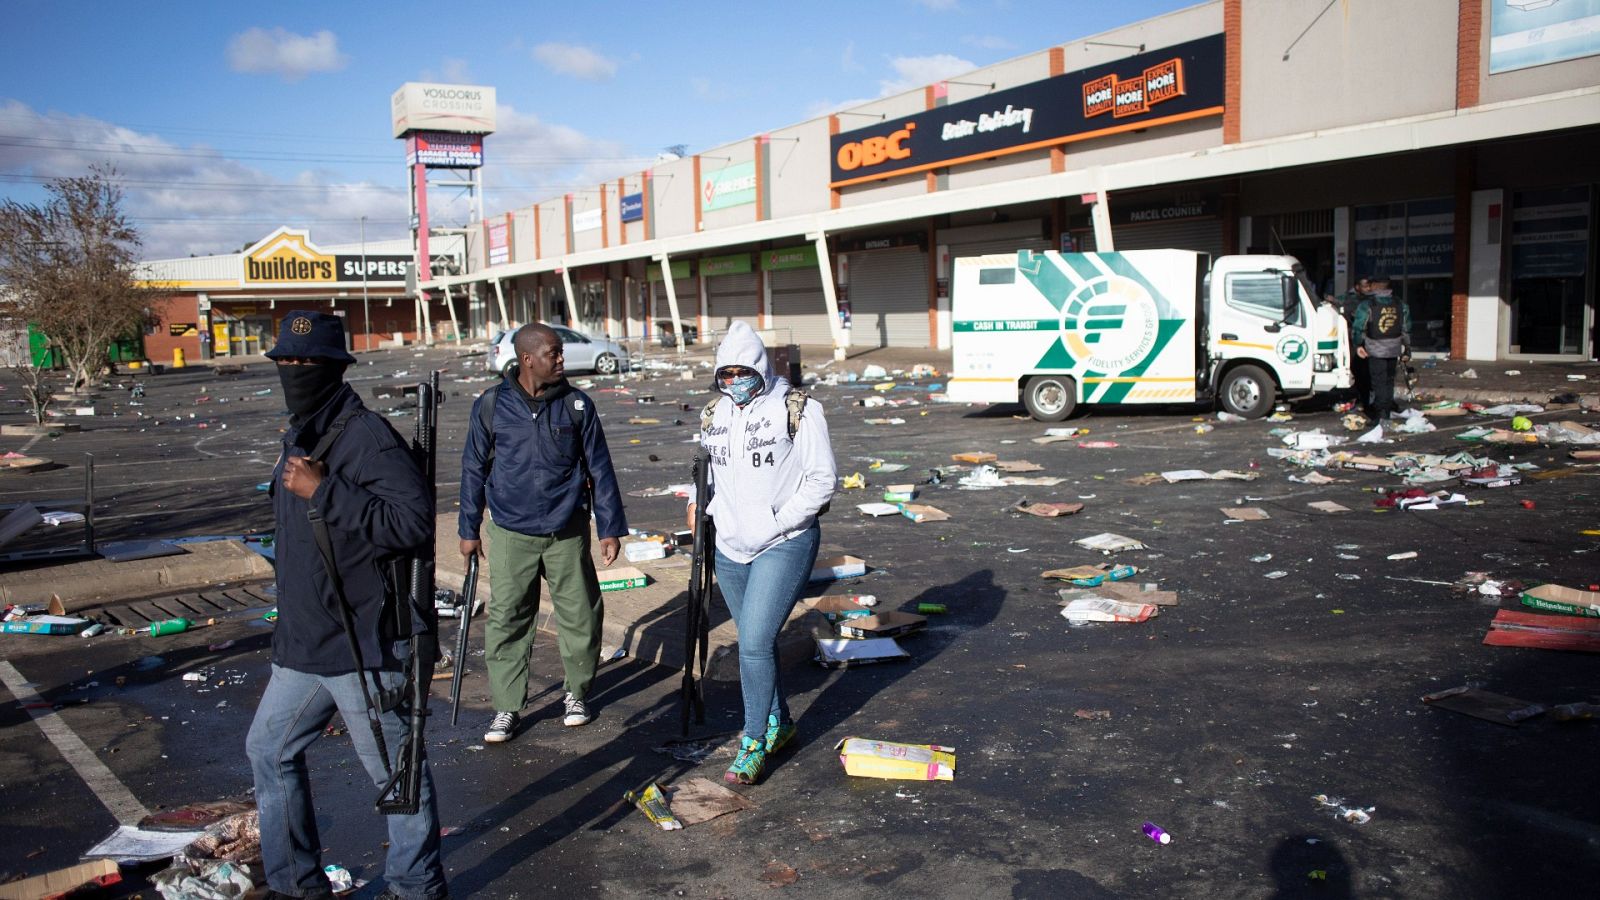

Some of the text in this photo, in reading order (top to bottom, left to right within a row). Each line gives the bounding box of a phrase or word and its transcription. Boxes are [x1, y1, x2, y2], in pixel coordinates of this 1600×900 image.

[1147, 63, 1175, 80] EXPECT
[1086, 79, 1112, 94] EXPECT
[1116, 79, 1143, 94] EXPECT
[1148, 73, 1175, 92] MORE
[423, 88, 481, 101] VOSLOORUS
[1086, 88, 1113, 106] MORE
[1116, 89, 1143, 106] MORE
[1149, 85, 1176, 102] VALUE
[422, 99, 481, 111] CROSSING
[1087, 101, 1113, 114] QUALITY
[1116, 102, 1143, 114] SERVICE
[837, 129, 912, 171] OBC
[1130, 205, 1203, 222] PARCEL COUNTER
[1366, 247, 1394, 257] SOCIAL
[248, 255, 415, 280] builders SUPERS
[973, 320, 1039, 331] CASH IN TRANSIT
[1088, 356, 1123, 369] FIDELITY
[1125, 331, 1153, 365] SERVICES
[752, 451, 775, 468] 84
